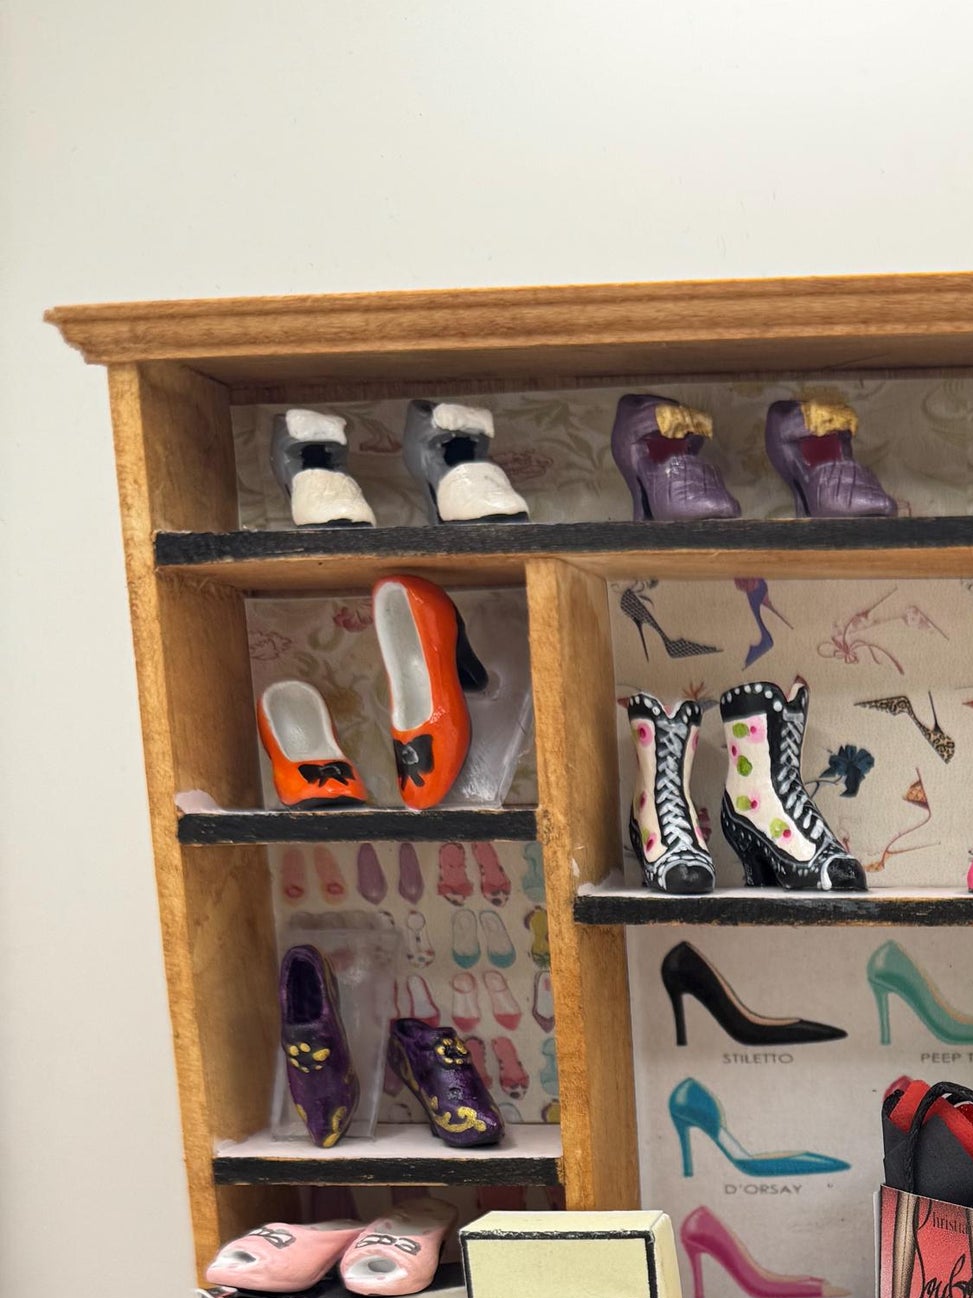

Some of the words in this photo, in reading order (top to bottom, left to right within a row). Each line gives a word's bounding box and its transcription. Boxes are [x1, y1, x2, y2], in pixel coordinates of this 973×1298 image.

[722, 1052, 794, 1065] STILETTO
[920, 1052, 962, 1064] PEEP
[724, 1183, 803, 1195] D'ORSAY
